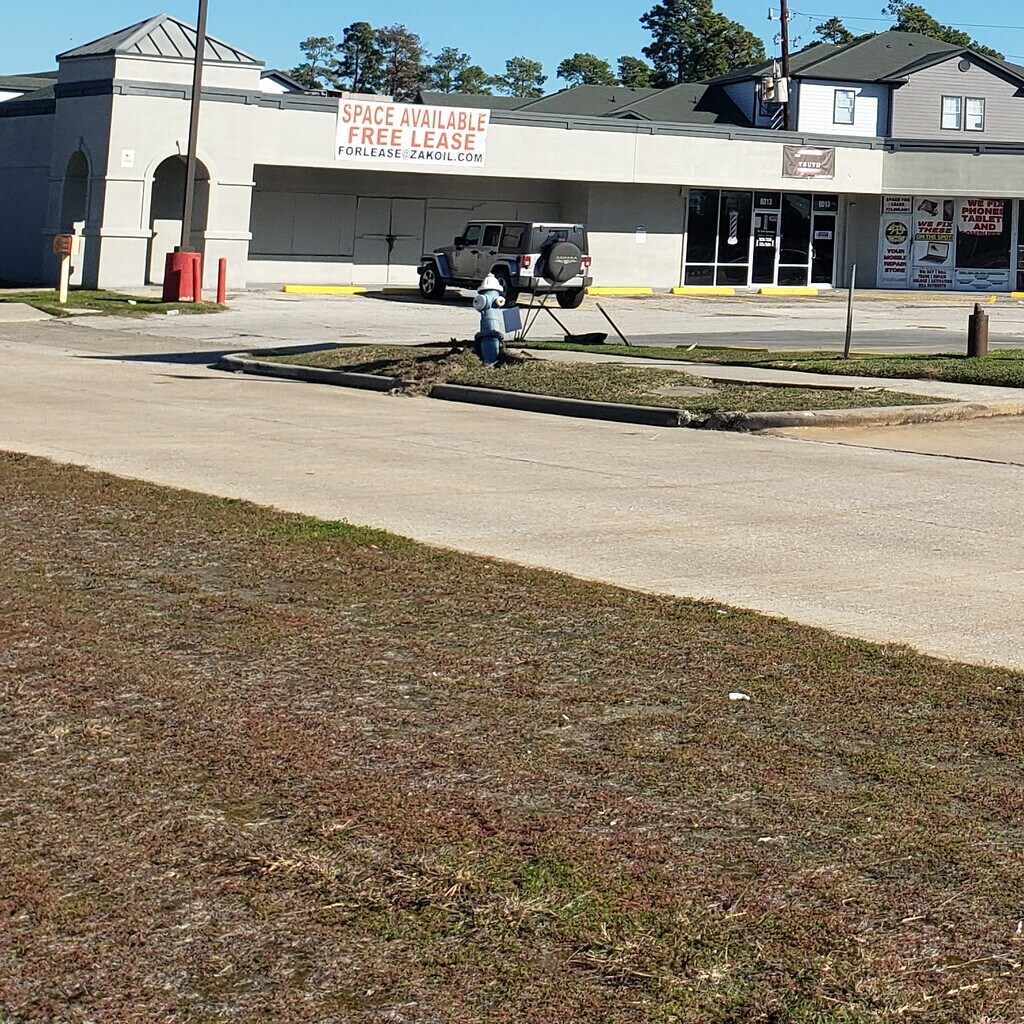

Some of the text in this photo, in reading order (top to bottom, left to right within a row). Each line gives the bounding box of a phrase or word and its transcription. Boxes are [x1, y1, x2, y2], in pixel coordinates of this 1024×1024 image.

[342, 104, 487, 132] SPACE AVAILABLE
[348, 126, 476, 151] FREE LEASE
[338, 145, 483, 163] FORLEASE@ZAKOIL.COM
[967, 199, 984, 207] WE
